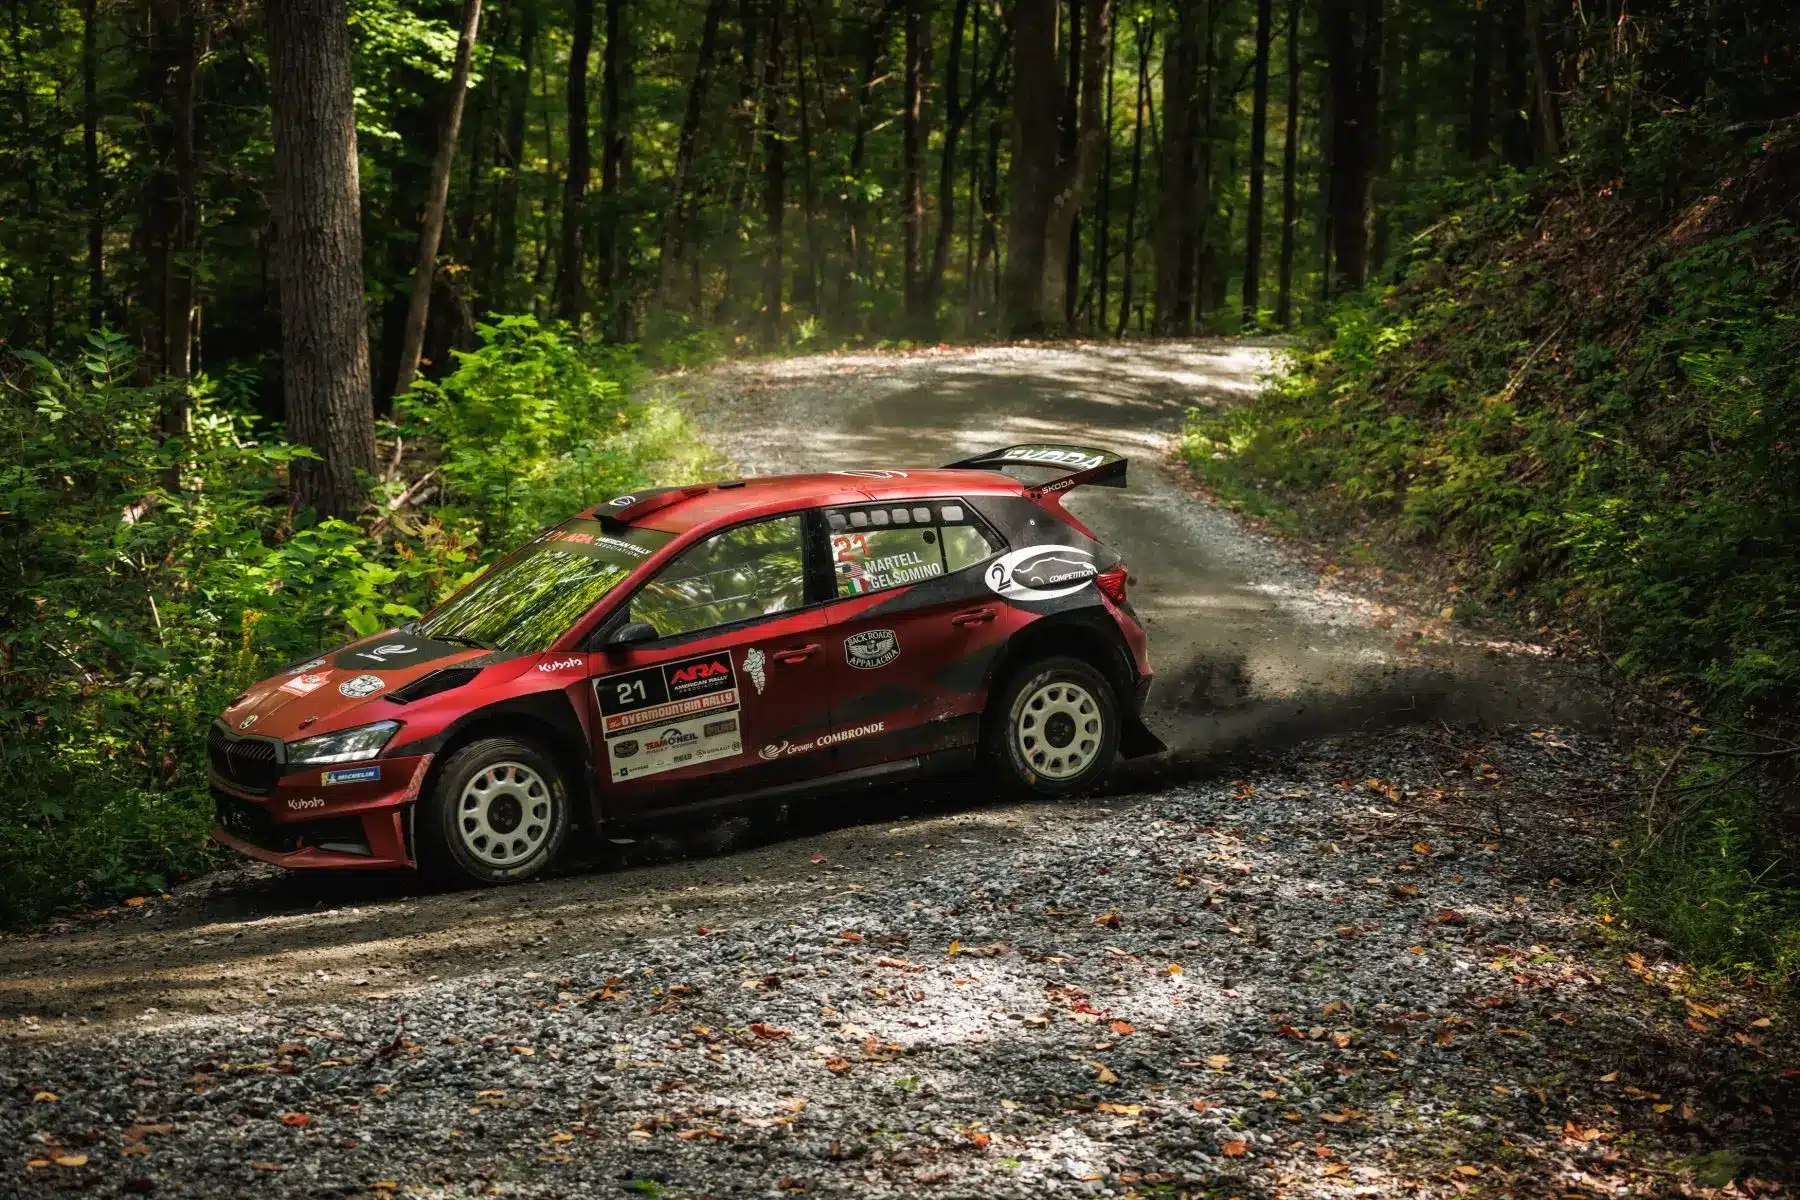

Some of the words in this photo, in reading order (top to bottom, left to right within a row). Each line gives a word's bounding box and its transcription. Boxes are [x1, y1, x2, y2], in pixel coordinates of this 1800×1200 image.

[630, 544, 652, 554] RALLY
[834, 533, 870, 562] 21
[864, 552, 922, 574] MARTELL
[871, 563, 940, 589] GELSOMINO
[1050, 570, 1094, 582] COMPETITION
[848, 633, 868, 646] BACK
[868, 632, 893, 640] ROADS
[538, 658, 582, 672] Kubota
[849, 649, 898, 668] APPALACHIA
[670, 661, 730, 684] ARA
[674, 680, 708, 690] AMERICAN
[708, 674, 728, 684] RALLY
[617, 680, 646, 704] 21
[622, 700, 702, 726] OVERMOUNTAIN
[702, 691, 734, 708] RALLY
[644, 739, 668, 750] TEAM
[787, 742, 814, 754] Groupe
[816, 722, 884, 746] COMBRONDE
[337, 771, 374, 780] MICHELIN
[288, 797, 325, 810] Kubota
